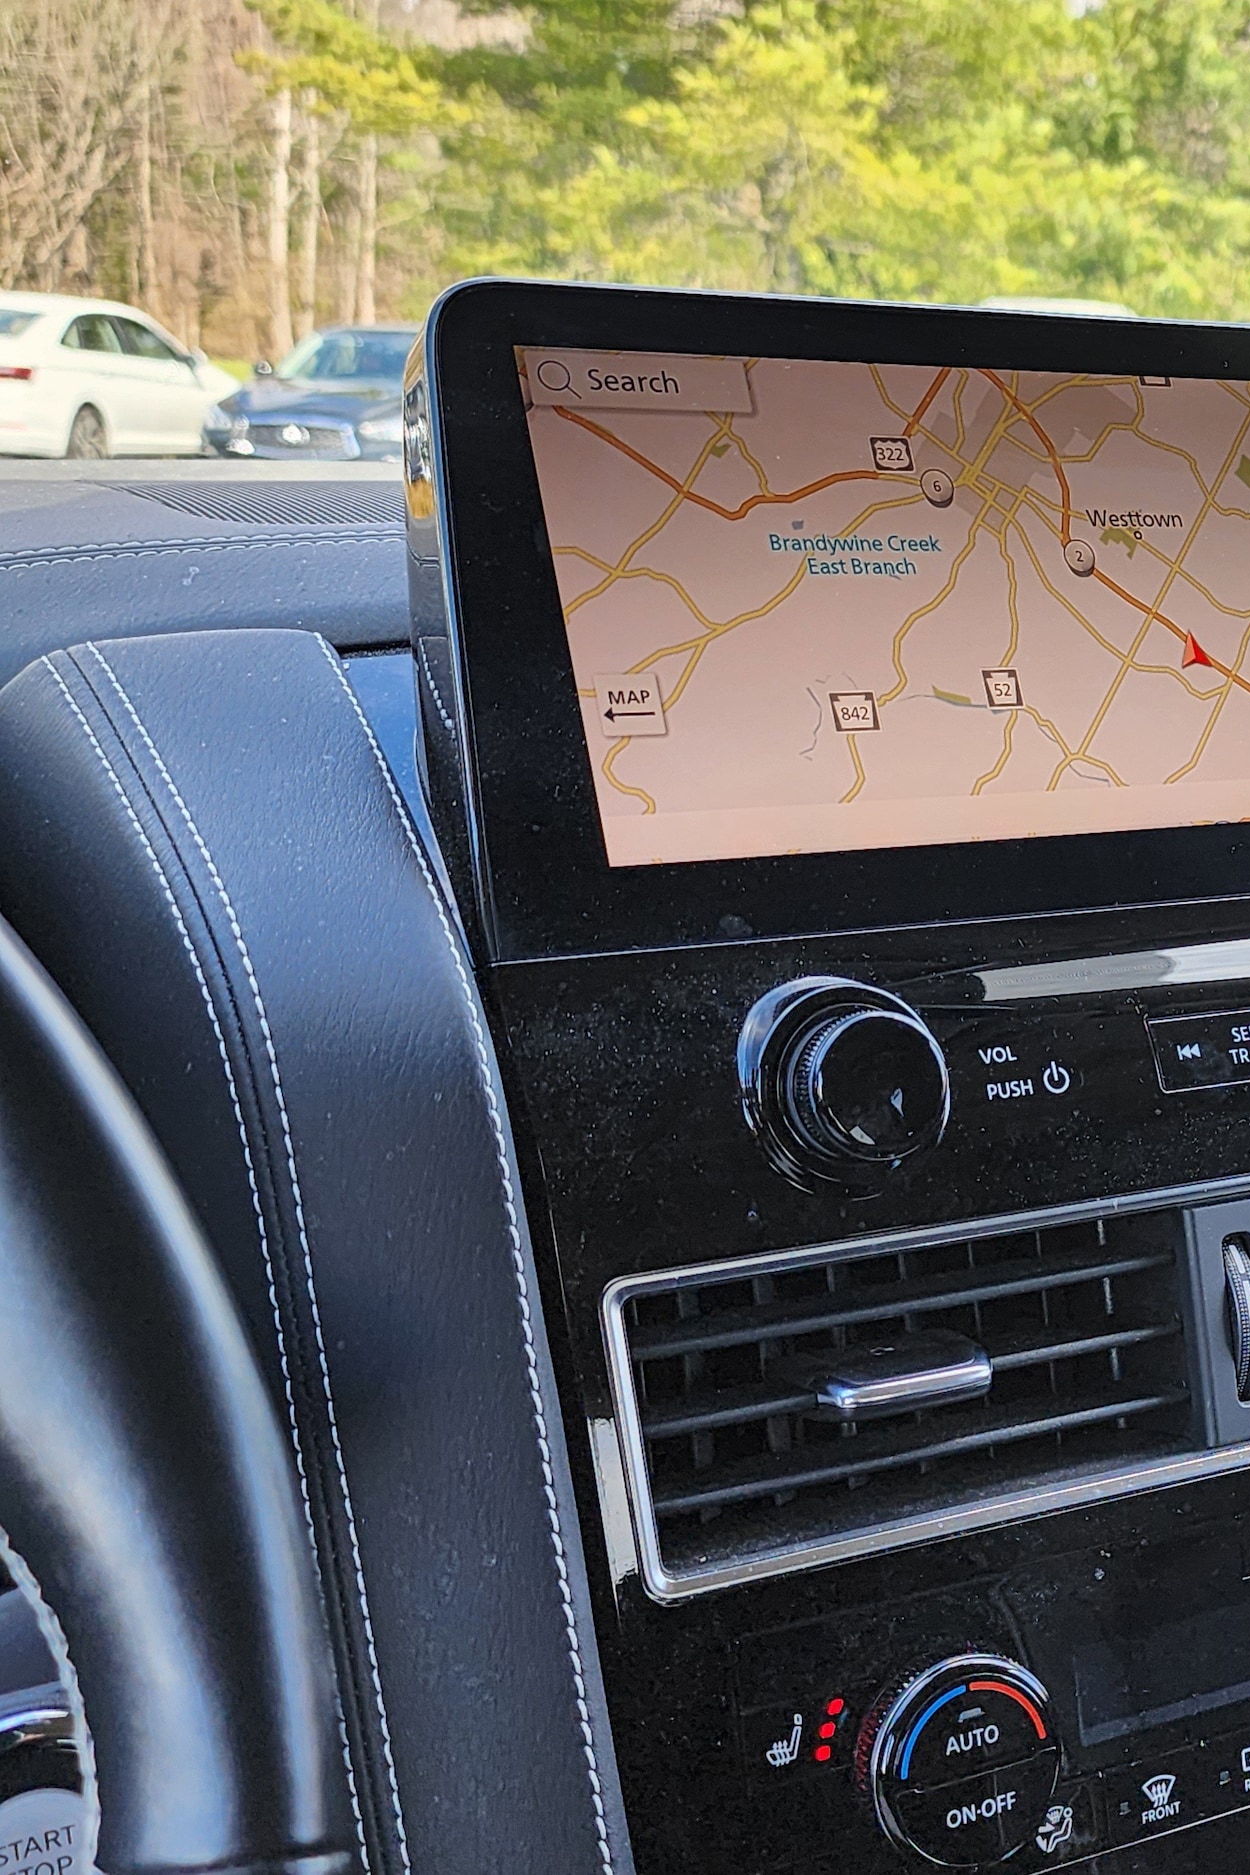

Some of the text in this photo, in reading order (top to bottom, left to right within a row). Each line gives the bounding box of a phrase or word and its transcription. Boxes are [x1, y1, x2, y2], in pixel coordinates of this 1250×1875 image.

[588, 368, 680, 395] Search
[876, 447, 905, 461] 322
[933, 480, 941, 492] 6
[1086, 509, 1183, 528] Westtown
[769, 534, 942, 555] Brandywine Creek
[1075, 550, 1084, 563] 2
[808, 557, 917, 576] East Branch
[607, 689, 651, 705] MAP
[994, 683, 1013, 697] 52
[841, 706, 870, 721] 842
[978, 1046, 1018, 1065] VOL
[986, 1079, 1034, 1101] PUSH
[946, 1725, 999, 1756] AUTO
[1142, 1800, 1181, 1824] FRONT
